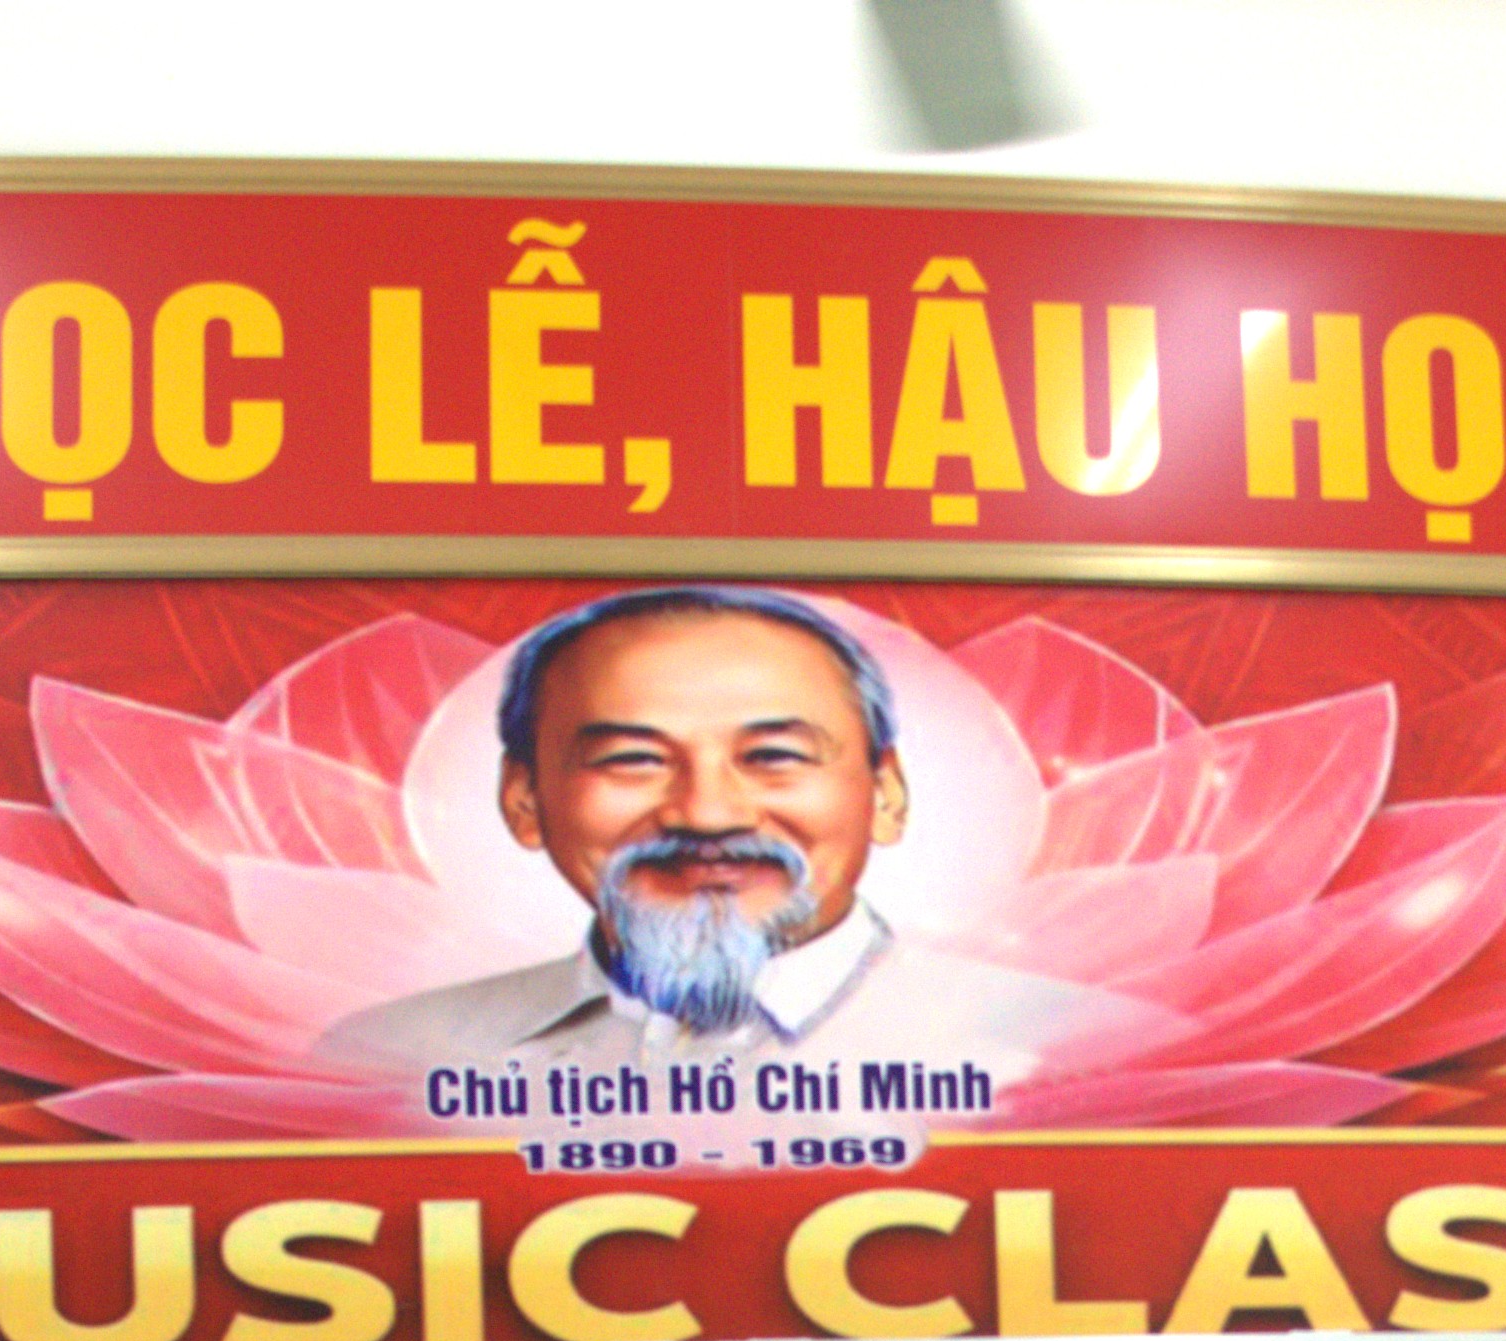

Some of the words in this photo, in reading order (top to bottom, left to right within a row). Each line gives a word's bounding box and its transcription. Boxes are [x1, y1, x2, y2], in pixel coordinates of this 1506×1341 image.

[367, 219, 672, 513] LỄ,
[739, 257, 1162, 527] HẬU
[427, 1061, 528, 1118] Chủ
[547, 1065, 649, 1127] tịch
[669, 1056, 735, 1114] Hồ
[756, 1061, 840, 1114] Chí
[861, 1062, 992, 1112] Minh
[520, 1140, 678, 1171] 1890
[751, 1136, 906, 1168] 1969
